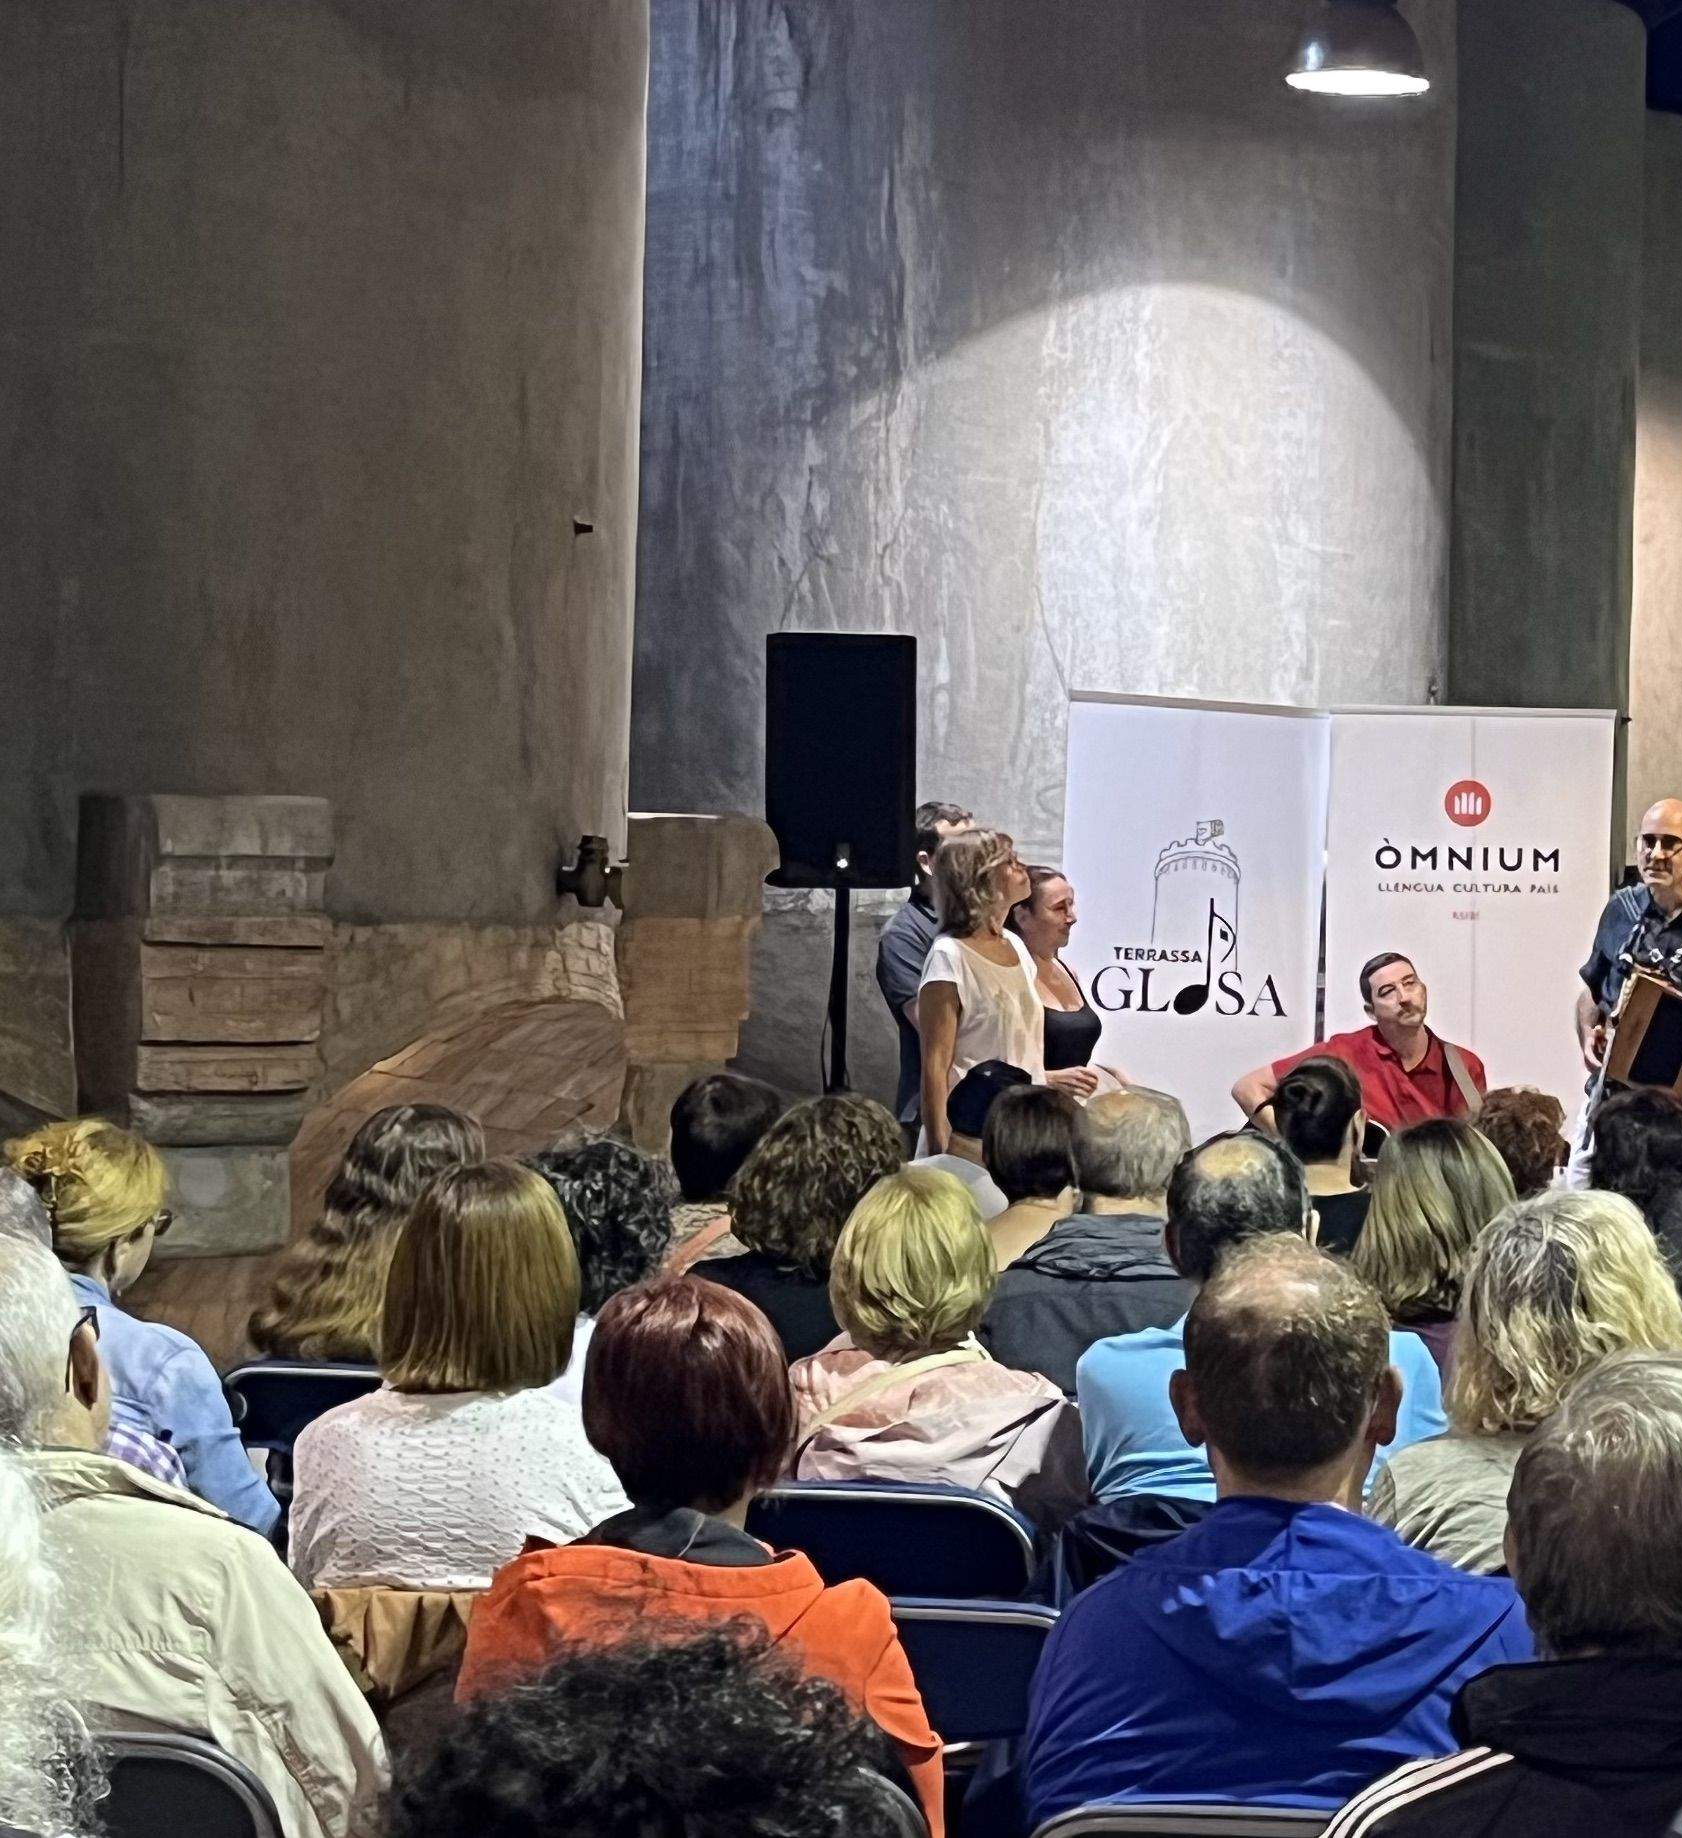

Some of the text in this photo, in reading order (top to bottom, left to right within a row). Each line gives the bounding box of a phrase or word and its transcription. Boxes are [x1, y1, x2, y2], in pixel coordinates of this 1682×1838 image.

[1375, 837, 1560, 872] ÒMNIUM
[1453, 883, 1522, 893] CULTURA
[1113, 946, 1203, 963] TERRASSA
